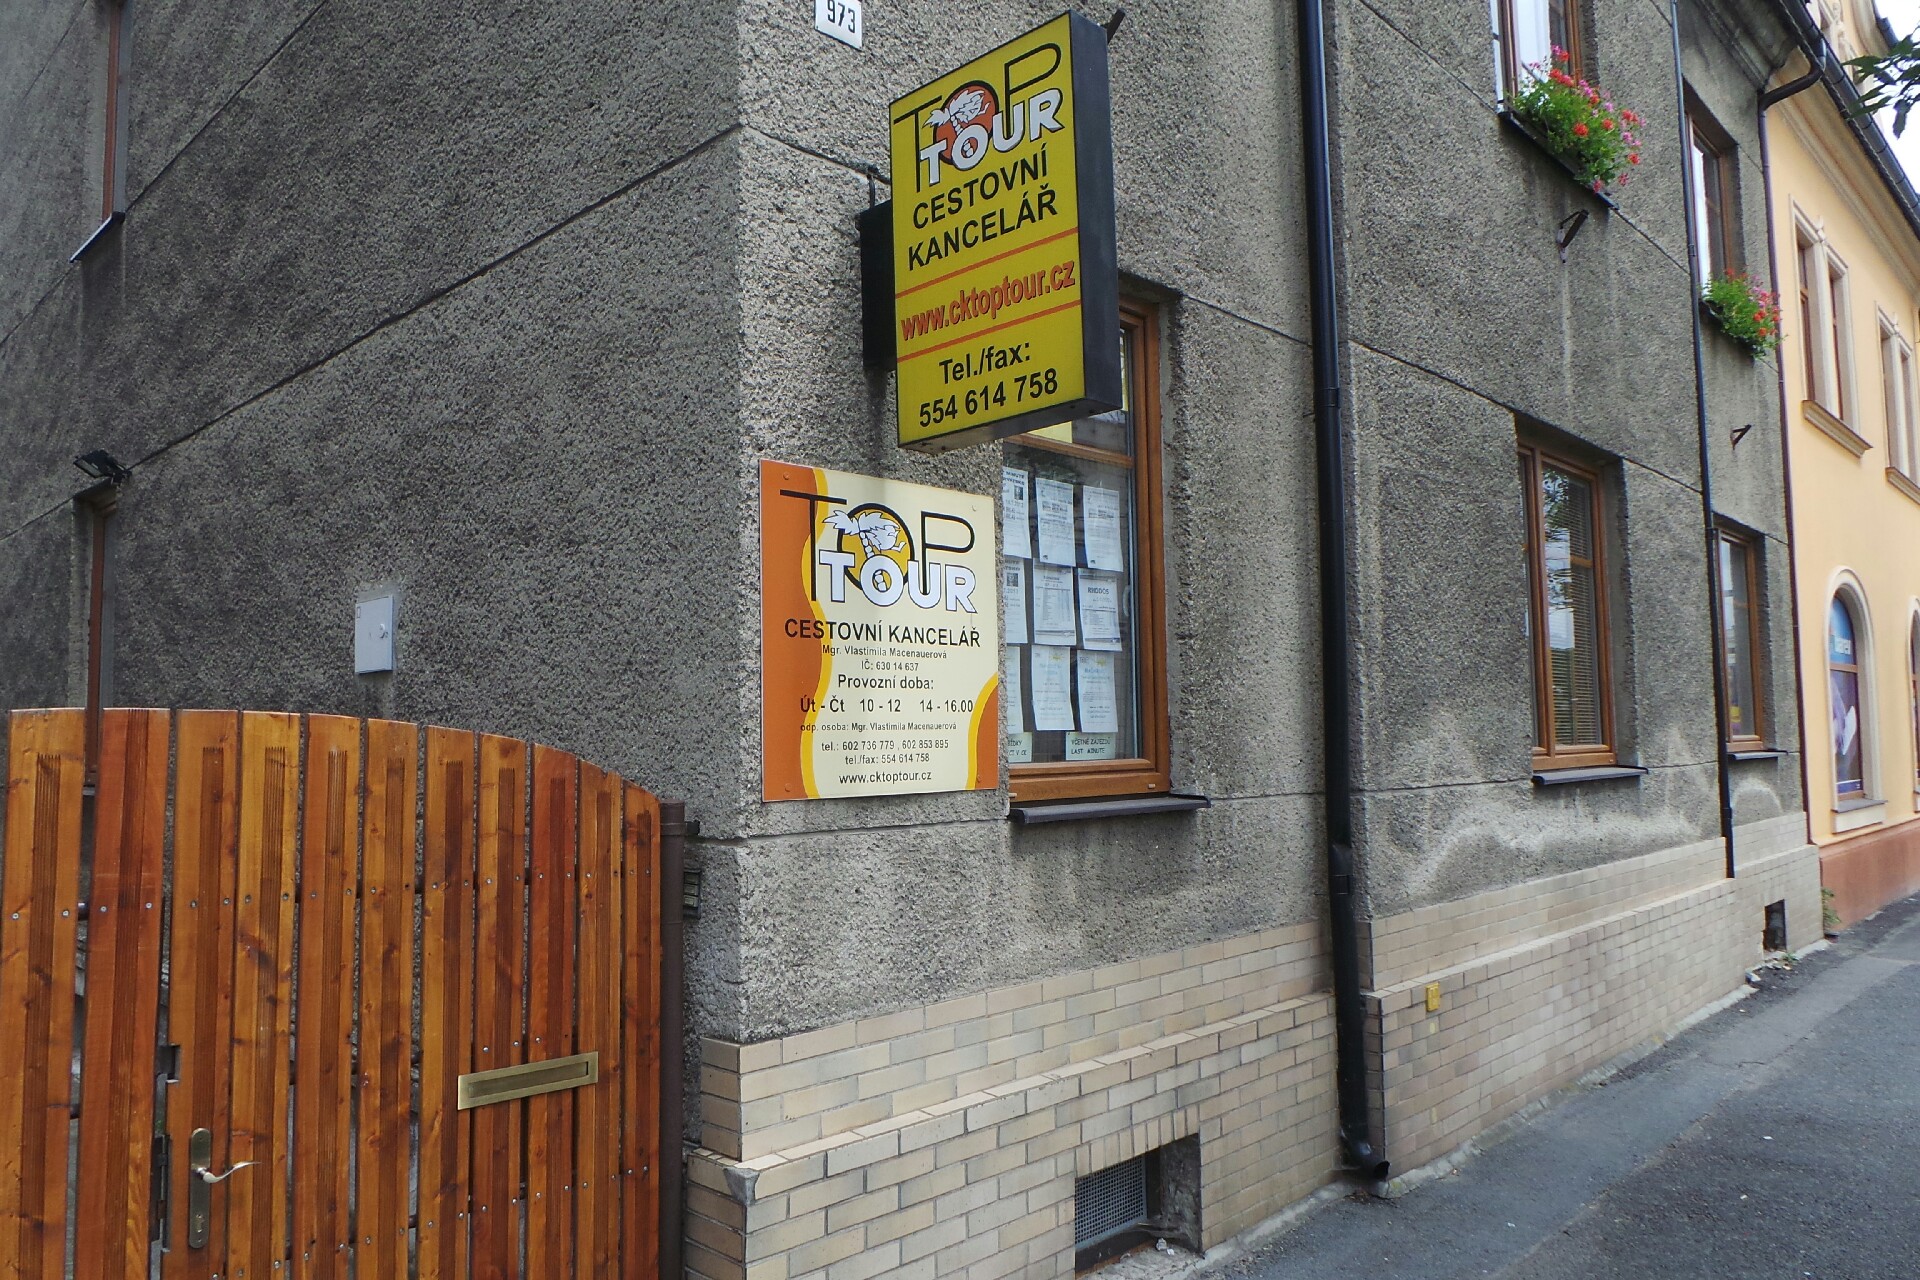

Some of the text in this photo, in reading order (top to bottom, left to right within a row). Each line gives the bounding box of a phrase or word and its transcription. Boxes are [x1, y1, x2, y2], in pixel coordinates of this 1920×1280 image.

[827, 0, 856, 34] 973
[894, 43, 1062, 193] TOP
[920, 88, 1065, 187] TOUR
[912, 143, 1048, 230] CESTOVNÍ
[908, 183, 1058, 271] KANCELÁŘ
[900, 260, 1076, 341] www.cktoptour.cz
[938, 341, 1031, 385] Tel./fax:
[918, 368, 1059, 428] 554 614 758
[780, 489, 976, 602] TOP
[818, 549, 978, 614] TOUR
[784, 617, 883, 643] CESTOVNÍ
[888, 625, 981, 648] KANCELÁŘ
[821, 644, 948, 659] Mgr. Vlastimila Macenauerová
[861, 658, 919, 672] IČ: 630 14 637
[837, 673, 934, 690] Provozní doba:
[800, 694, 816, 713] Út
[829, 695, 846, 713] Čt
[859, 698, 875, 713] 10
[887, 698, 901, 713] 12
[919, 699, 933, 712] 14
[944, 699, 974, 713] 16.00
[800, 722, 819, 733] odp.
[821, 722, 850, 732] osoba:
[851, 722, 868, 733] Mgr.
[869, 722, 906, 731] Vlastimila
[821, 742, 840, 752] tel.:
[842, 740, 859, 751] 602
[861, 740, 877, 751] 736
[879, 740, 895, 750] 779
[902, 740, 917, 750] 602
[918, 739, 933, 749] 853
[934, 739, 949, 749] 895
[844, 752, 930, 765] tel./fax: 554 614 758
[838, 770, 932, 785] www.cktoptour.cz
